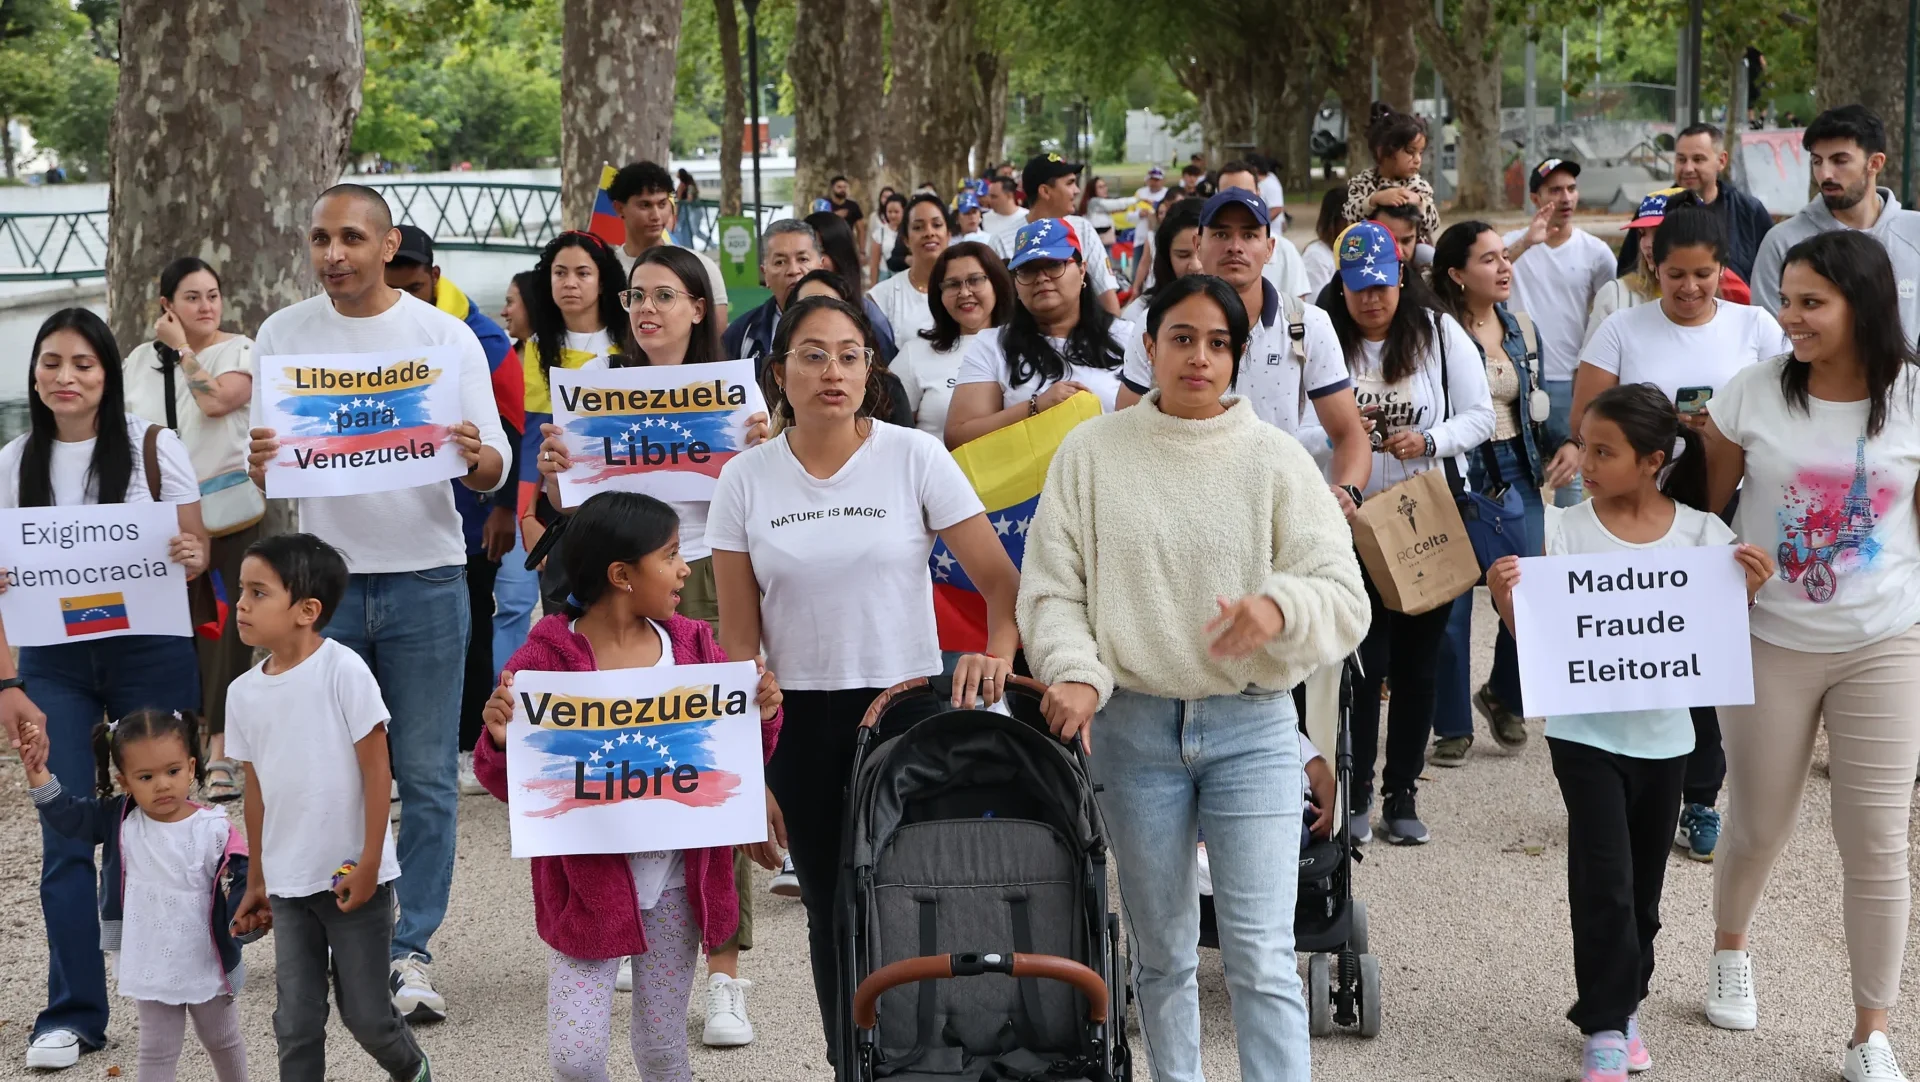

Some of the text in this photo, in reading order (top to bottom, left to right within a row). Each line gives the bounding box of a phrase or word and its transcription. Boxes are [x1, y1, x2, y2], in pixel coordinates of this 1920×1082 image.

[295, 361, 430, 389] Liberdade
[558, 379, 747, 412] Venezuela
[336, 407, 395, 434] para
[293, 438, 436, 470] Venezuela
[603, 435, 711, 466] Libre
[770, 506, 887, 529] NATURE IS MAGIC
[21, 520, 139, 549] Exigimos
[6, 558, 168, 587] democracia
[1567, 567, 1689, 594] Maduro
[1576, 610, 1685, 639] Fraude
[1568, 653, 1702, 684] Eleitoral
[520, 684, 748, 728] Venezuela
[574, 759, 699, 800] Libre
